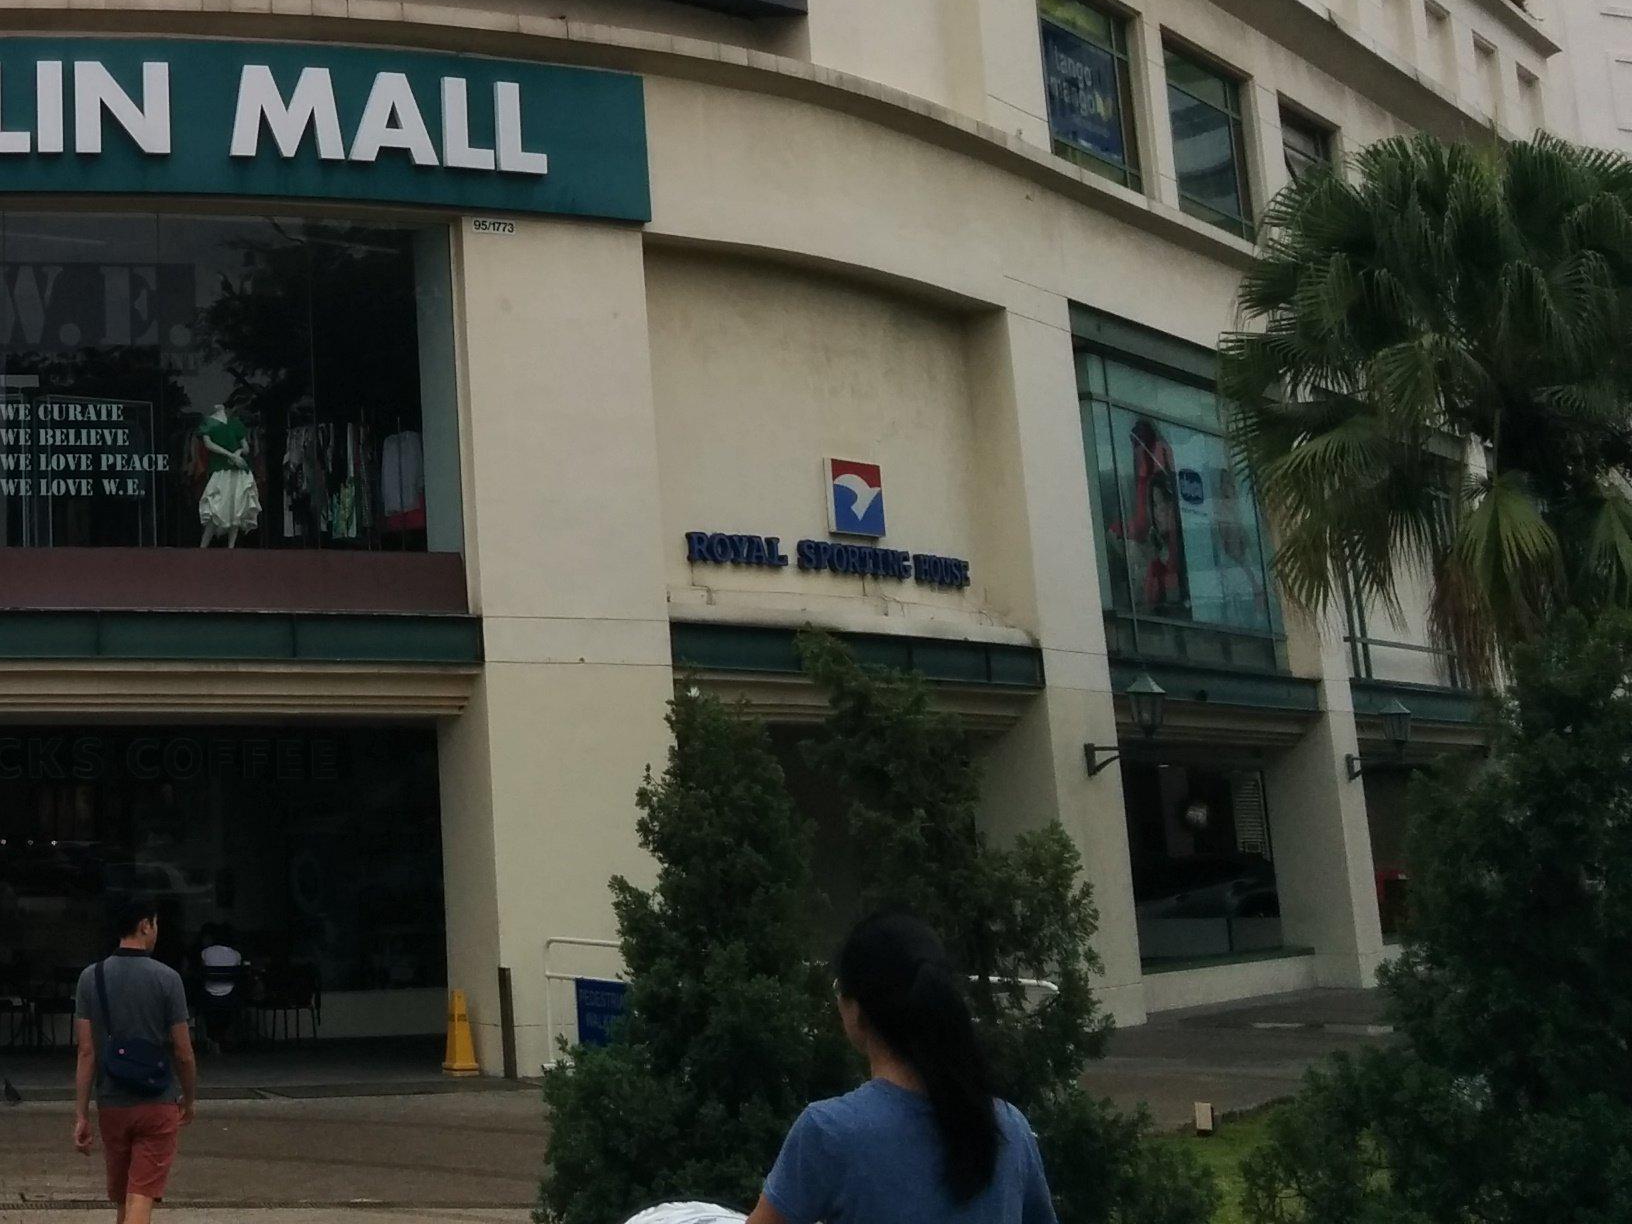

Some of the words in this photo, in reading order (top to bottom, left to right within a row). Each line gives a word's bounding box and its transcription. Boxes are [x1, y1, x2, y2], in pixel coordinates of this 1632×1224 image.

[229, 66, 549, 175] MALL
[473, 219, 514, 233] 95/1773
[0, 404, 31, 421] WE
[37, 404, 125, 421] CURATE
[0, 428, 31, 446] WE
[38, 428, 130, 446] BELIEVE
[0, 453, 31, 471] WE
[39, 453, 93, 471] LOVE
[99, 453, 169, 471] PEACE
[0, 478, 31, 496] WE
[39, 478, 93, 496] LOVE
[102, 479, 146, 496] W.E.
[685, 532, 789, 566] ROYAL
[796, 539, 913, 579] SPORTING
[913, 554, 971, 587] HOUSE
[126, 737, 338, 780] COFFEE
